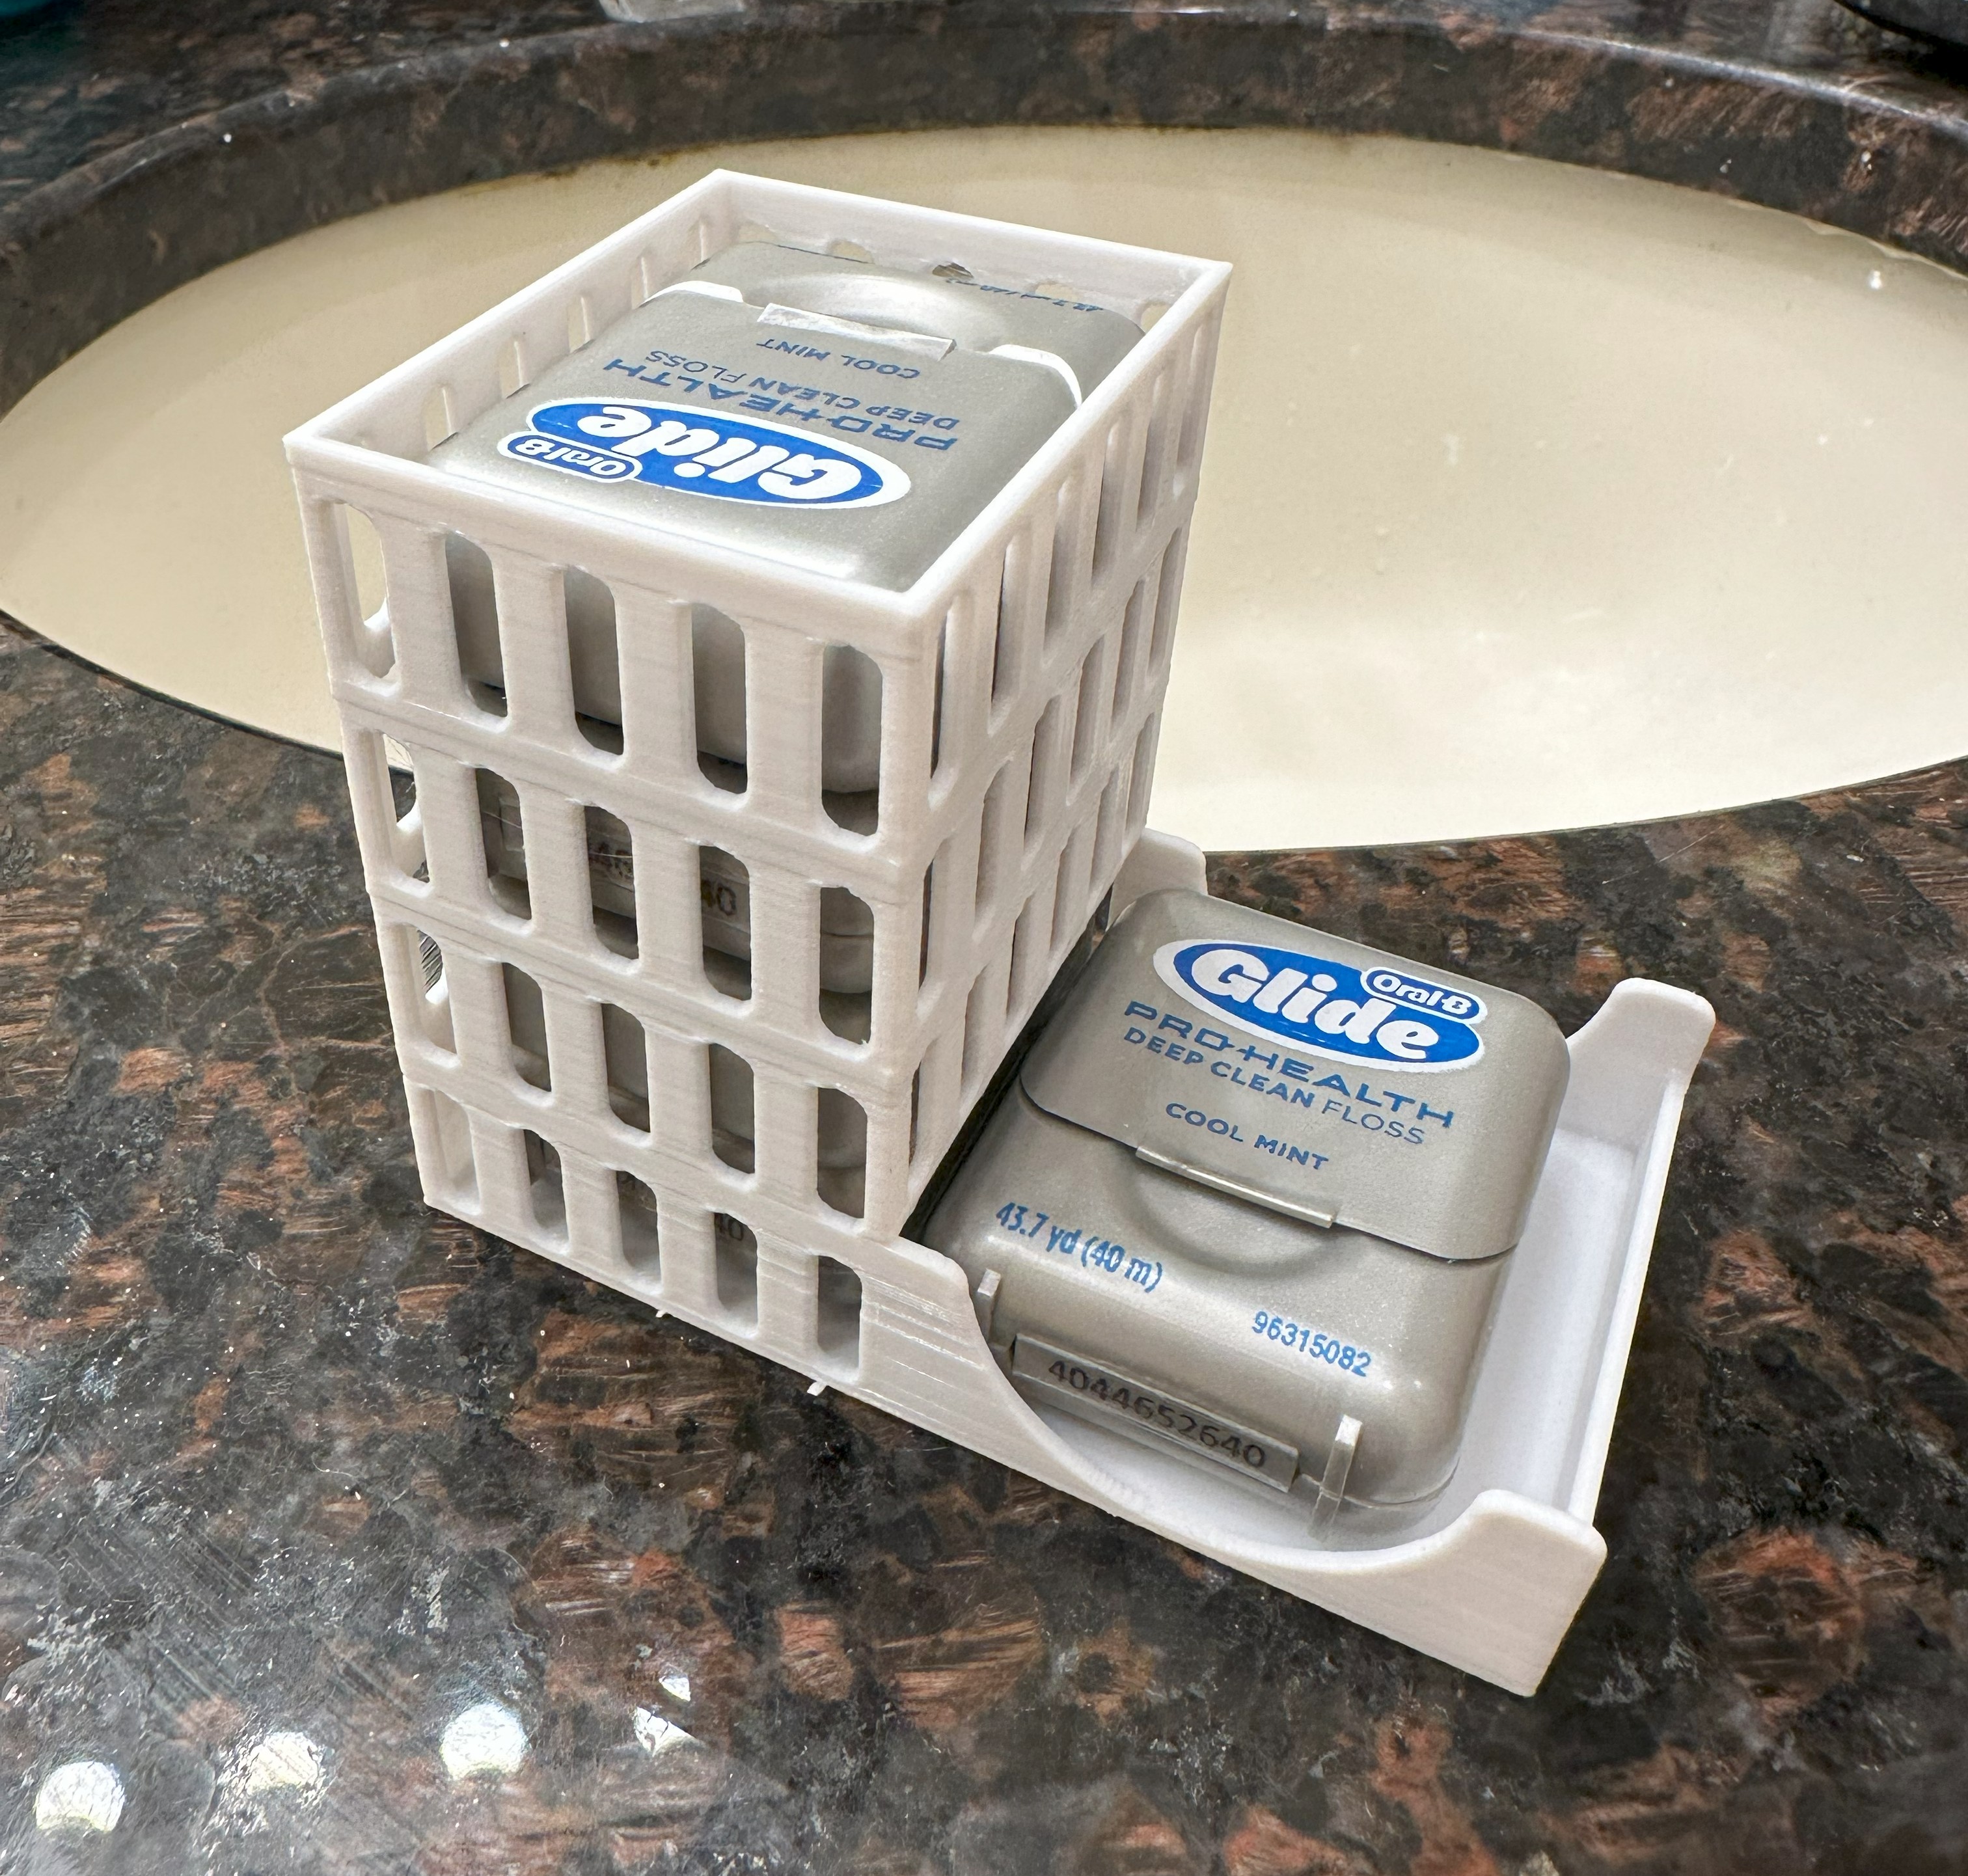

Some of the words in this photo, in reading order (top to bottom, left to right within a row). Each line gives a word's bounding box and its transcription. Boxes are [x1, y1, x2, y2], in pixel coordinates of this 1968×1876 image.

[645, 350, 746, 383] FLOSS
[756, 338, 831, 361] MINT
[842, 353, 921, 379] COOL
[748, 376, 860, 409] CLEAN
[865, 404, 960, 430] DEEP
[515, 439, 626, 476] Oral-B
[578, 406, 862, 499] Glide
[1192, 949, 1439, 1059] Glide
[1373, 974, 1472, 1014] Oral-B
[1124, 1027, 1204, 1065] DEEP
[1210, 1061, 1315, 1108] CLEAN
[1321, 1099, 1425, 1145] FLOSS
[1165, 1102, 1244, 1143] COOL
[1253, 1134, 1329, 1170] MINT
[996, 1202, 1049, 1238] 43.7
[1045, 1223, 1078, 1255] yd
[1080, 1236, 1125, 1273] (40
[1124, 1257, 1164, 1294] m)
[1251, 1311, 1372, 1378] 96315082
[1048, 1359, 1266, 1469] 4044652640
